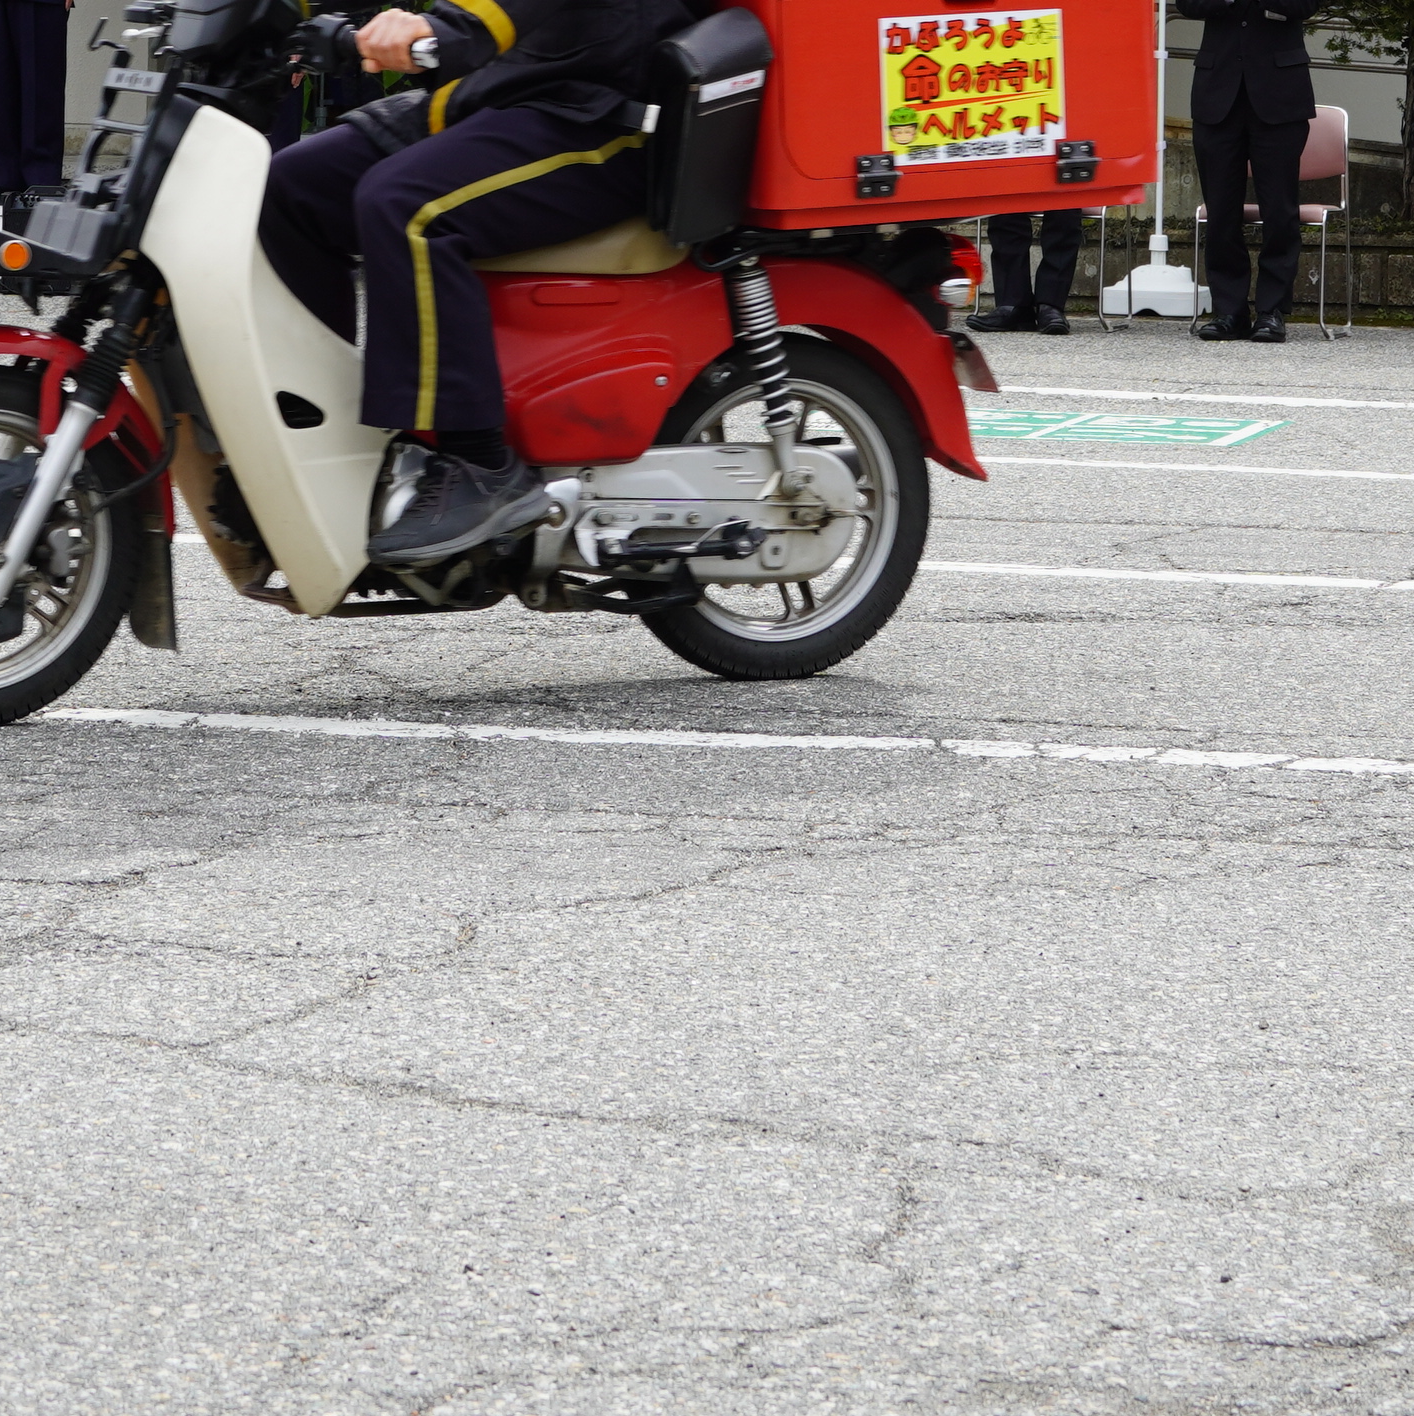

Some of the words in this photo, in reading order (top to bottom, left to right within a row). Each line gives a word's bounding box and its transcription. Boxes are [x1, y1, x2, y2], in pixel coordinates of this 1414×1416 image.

[885, 17, 1024, 54] かぶろうよ
[901, 54, 1053, 103] 命のお守り
[922, 102, 1060, 140] ヘルメット
